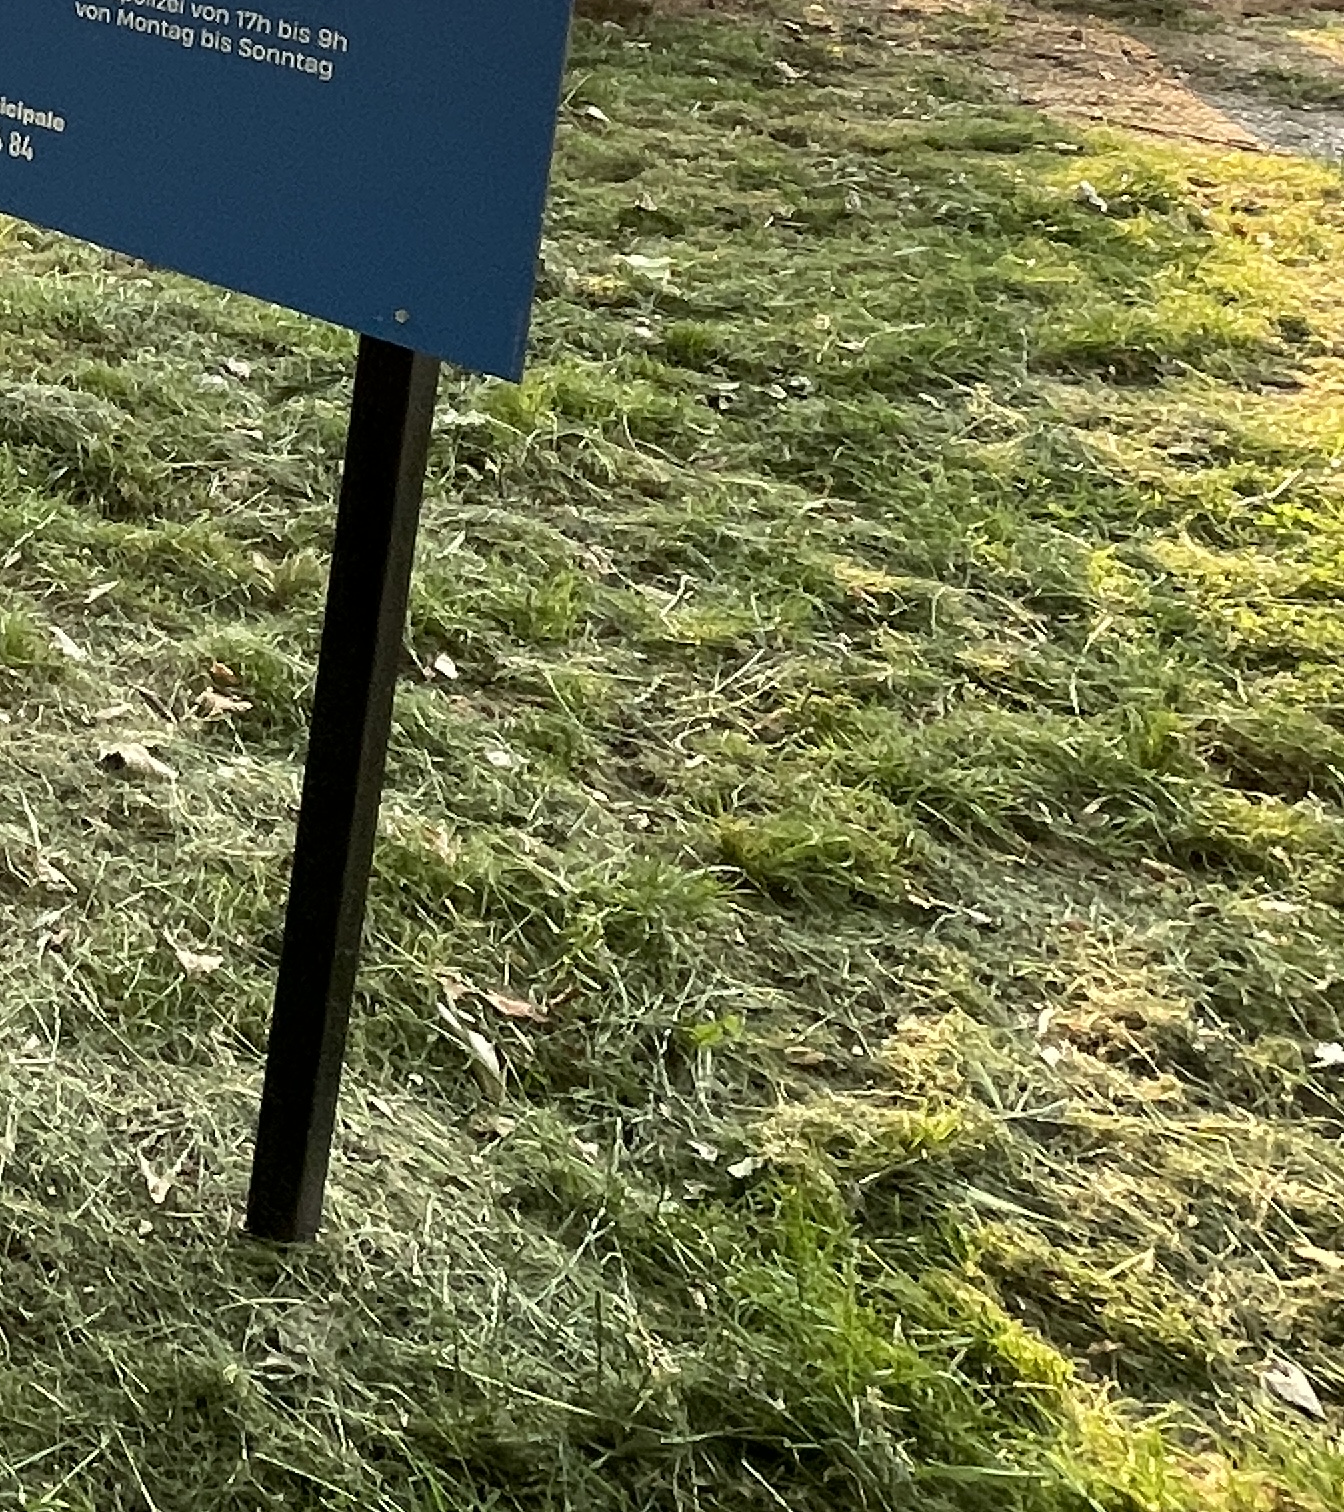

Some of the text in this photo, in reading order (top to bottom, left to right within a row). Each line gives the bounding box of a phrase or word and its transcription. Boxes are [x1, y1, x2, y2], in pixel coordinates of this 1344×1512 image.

[74, 0, 334, 82] von Montag bis Sonntag
[190, 3, 230, 26] von
[236, 9, 272, 34] 17h
[277, 18, 310, 44] bis
[318, 27, 349, 52] 9h
[8, 131, 34, 161] 84
